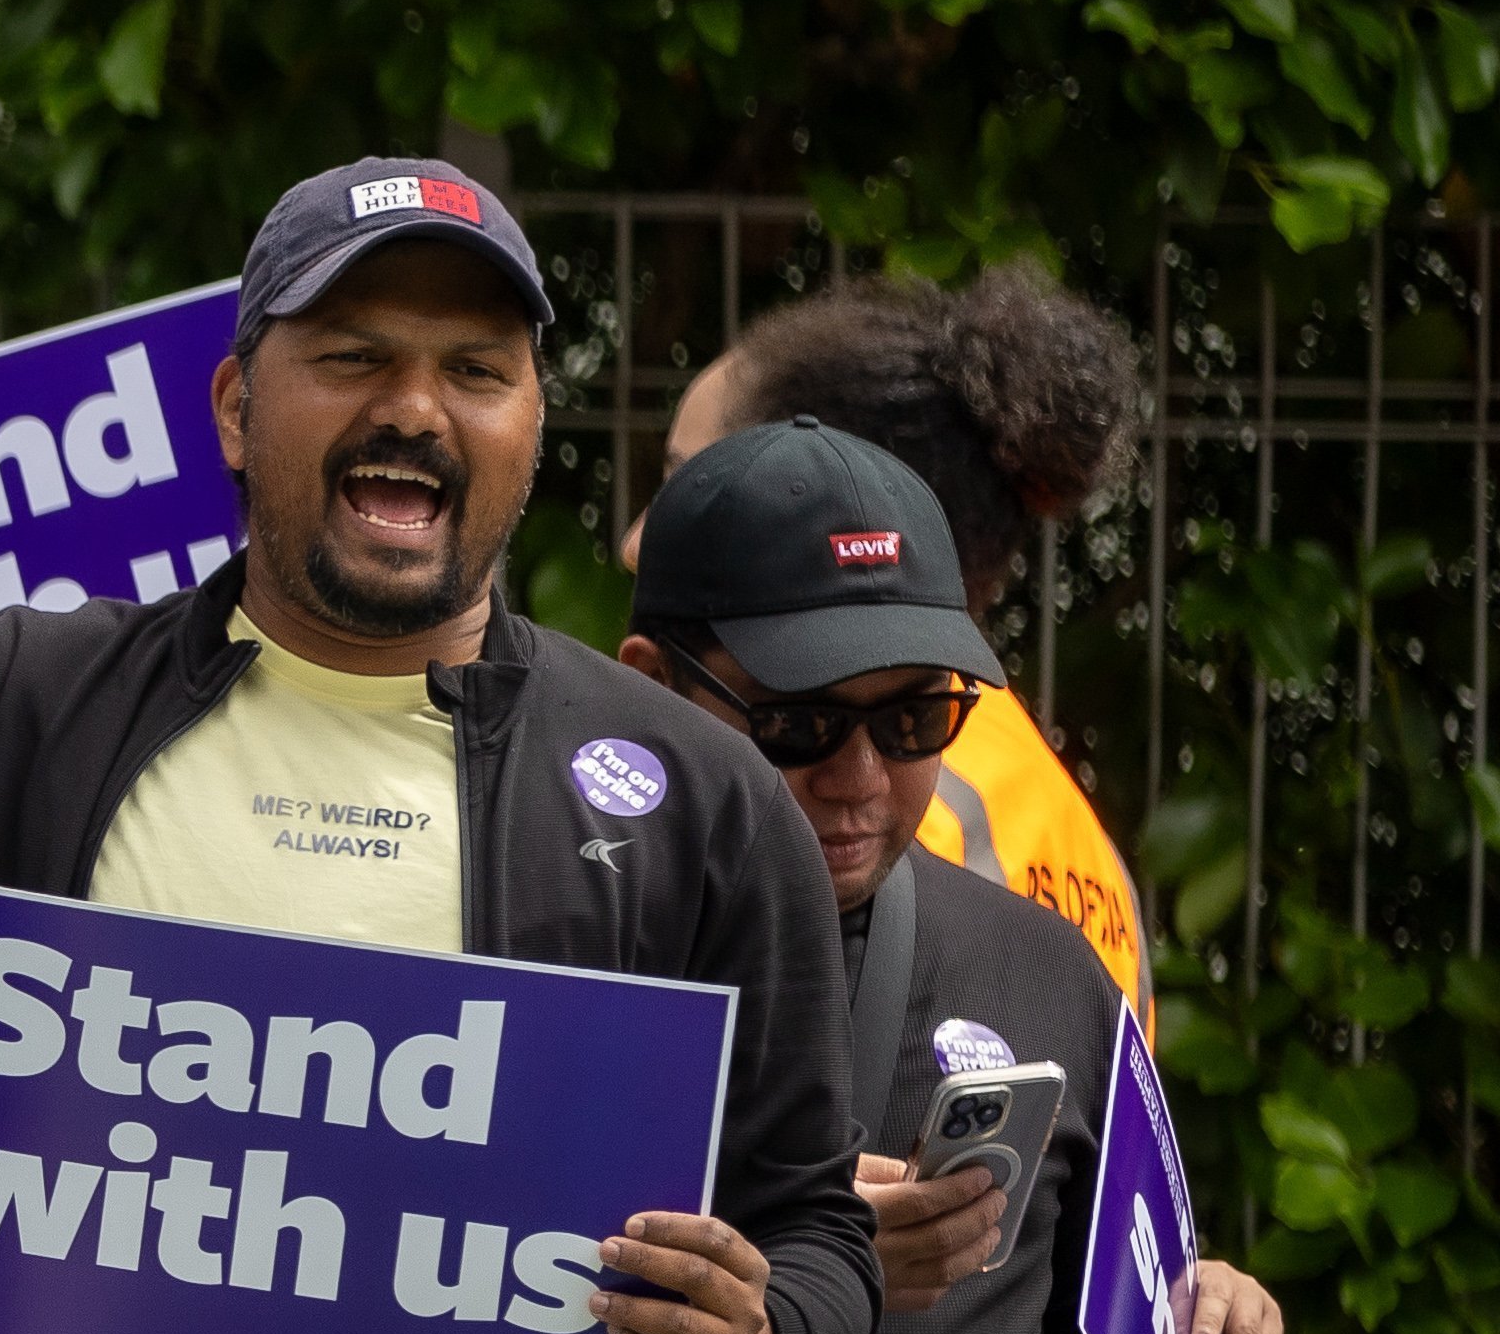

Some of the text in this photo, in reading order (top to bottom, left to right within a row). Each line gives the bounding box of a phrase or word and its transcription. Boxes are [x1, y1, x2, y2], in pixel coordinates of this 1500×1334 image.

[579, 757, 646, 810] Strike
[628, 770, 659, 796] on
[252, 794, 431, 831] ME? WEIRD?
[273, 829, 400, 860] ALWAYS!
[976, 1040, 1004, 1056] on
